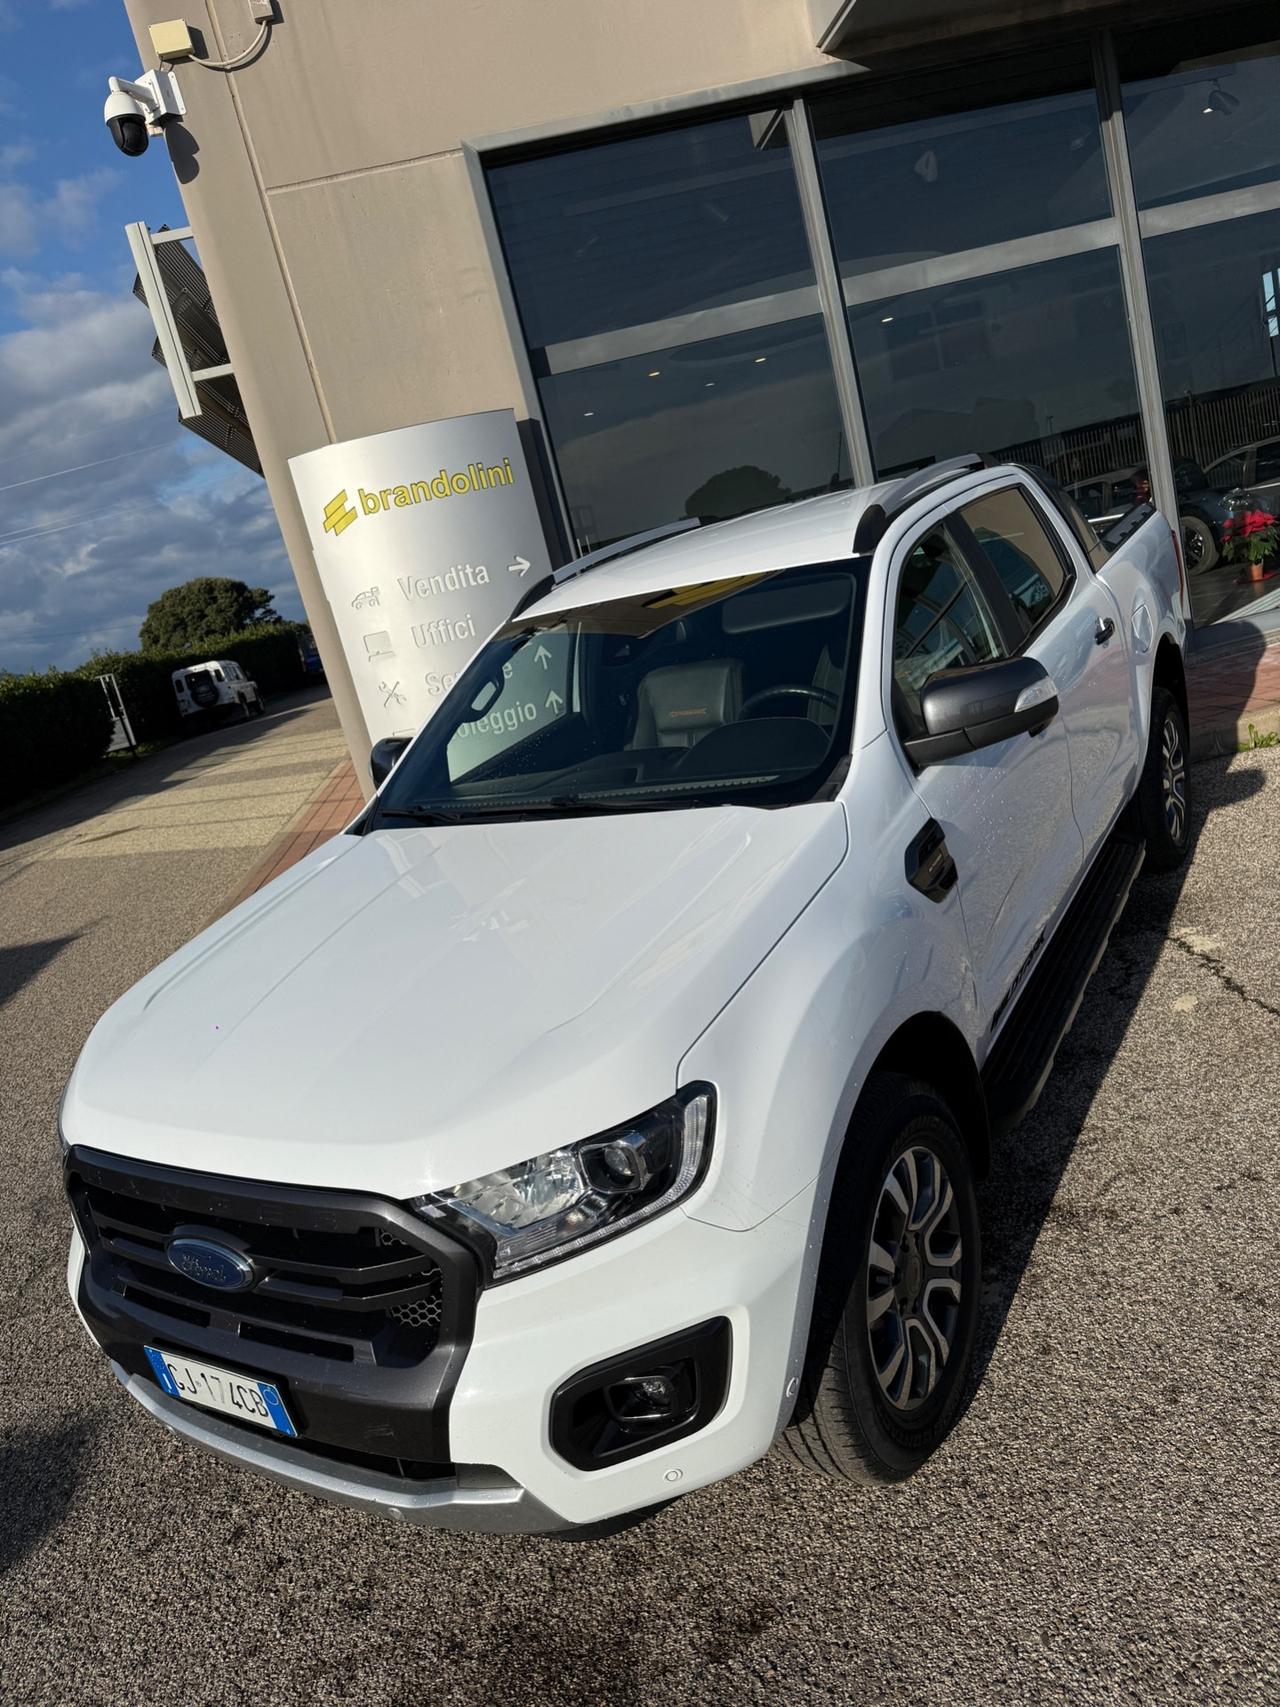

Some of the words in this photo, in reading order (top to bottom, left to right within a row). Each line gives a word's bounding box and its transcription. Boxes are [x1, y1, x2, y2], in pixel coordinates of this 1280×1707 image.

[358, 457, 514, 515] brandolini
[397, 564, 490, 602] Vendita
[410, 614, 476, 649] Uffici
[457, 701, 537, 738] oeggio
